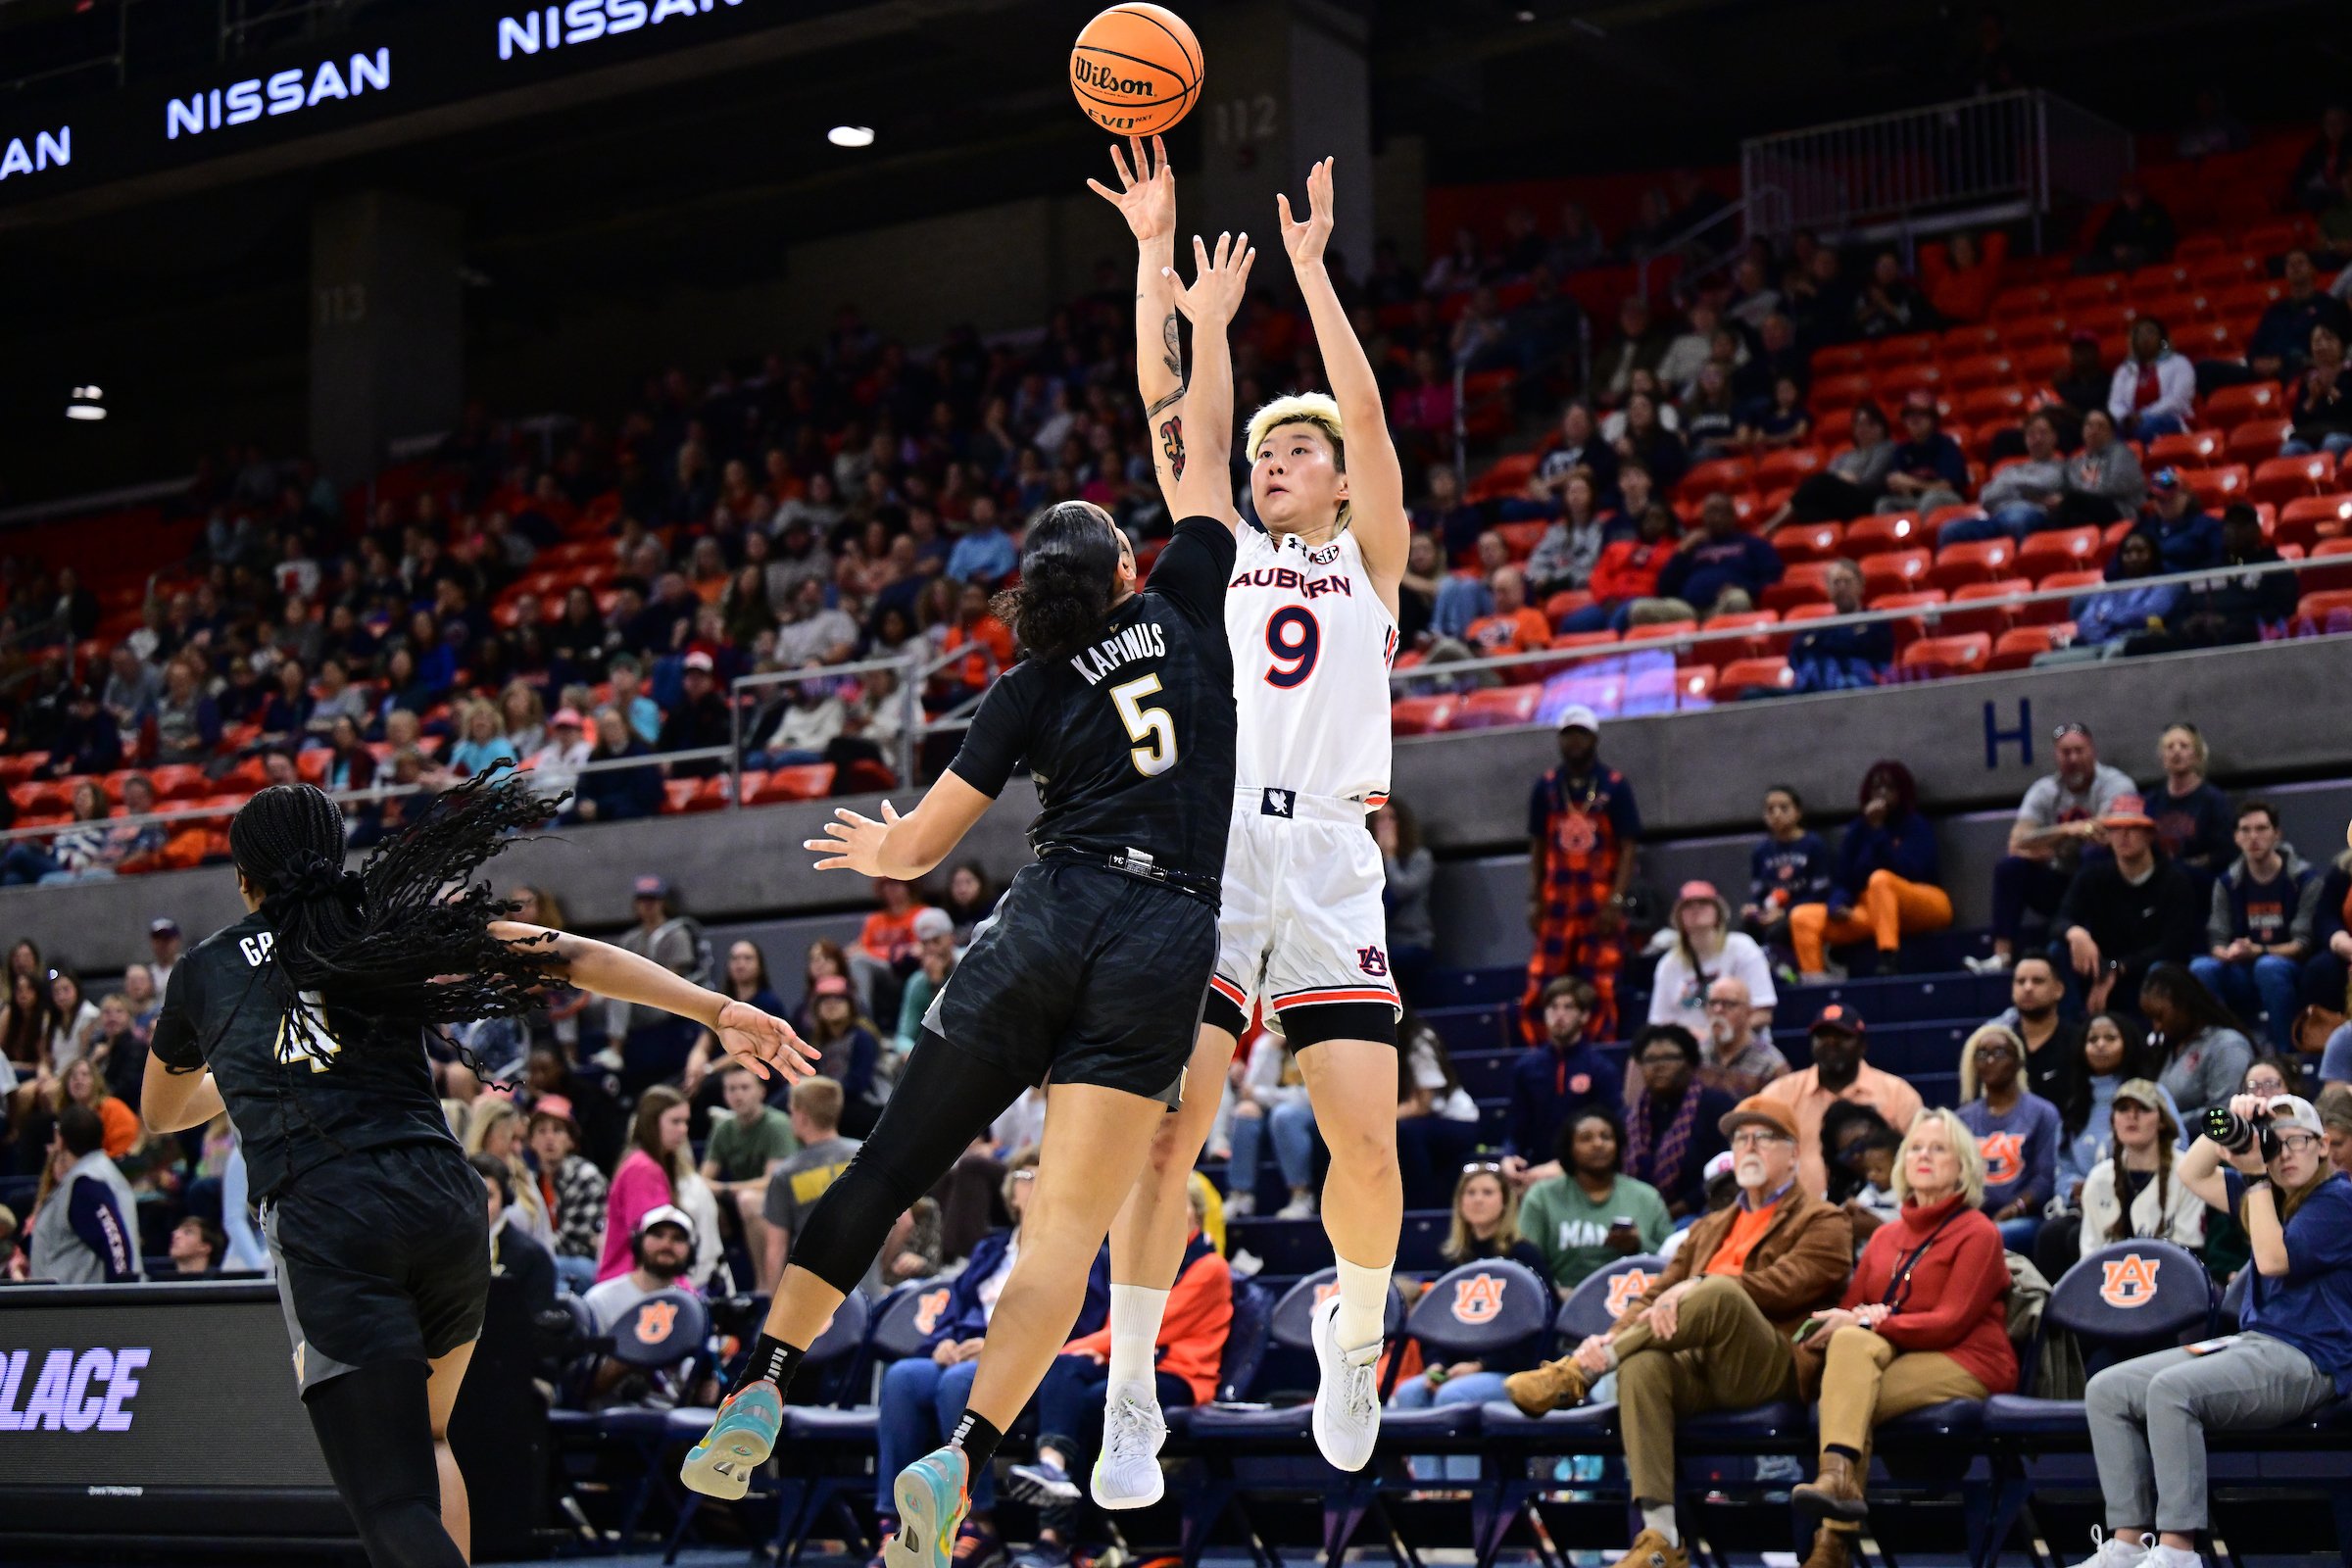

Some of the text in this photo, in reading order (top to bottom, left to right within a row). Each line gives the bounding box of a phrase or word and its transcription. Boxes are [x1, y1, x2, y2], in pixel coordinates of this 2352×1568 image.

[166, 46, 391, 140] NISSAN
[1075, 56, 1153, 97] Wilson
[1088, 108, 1134, 129] EVO
[1215, 95, 1277, 140] 112
[1315, 546, 1340, 564] SEC
[1069, 622, 1167, 686] KAPINUS
[1263, 604, 1321, 690] 9
[1108, 671, 1180, 778] 5
[1983, 697, 2034, 769] H
[273, 990, 342, 1074] 4
[0, 1347, 152, 1432] LACE
